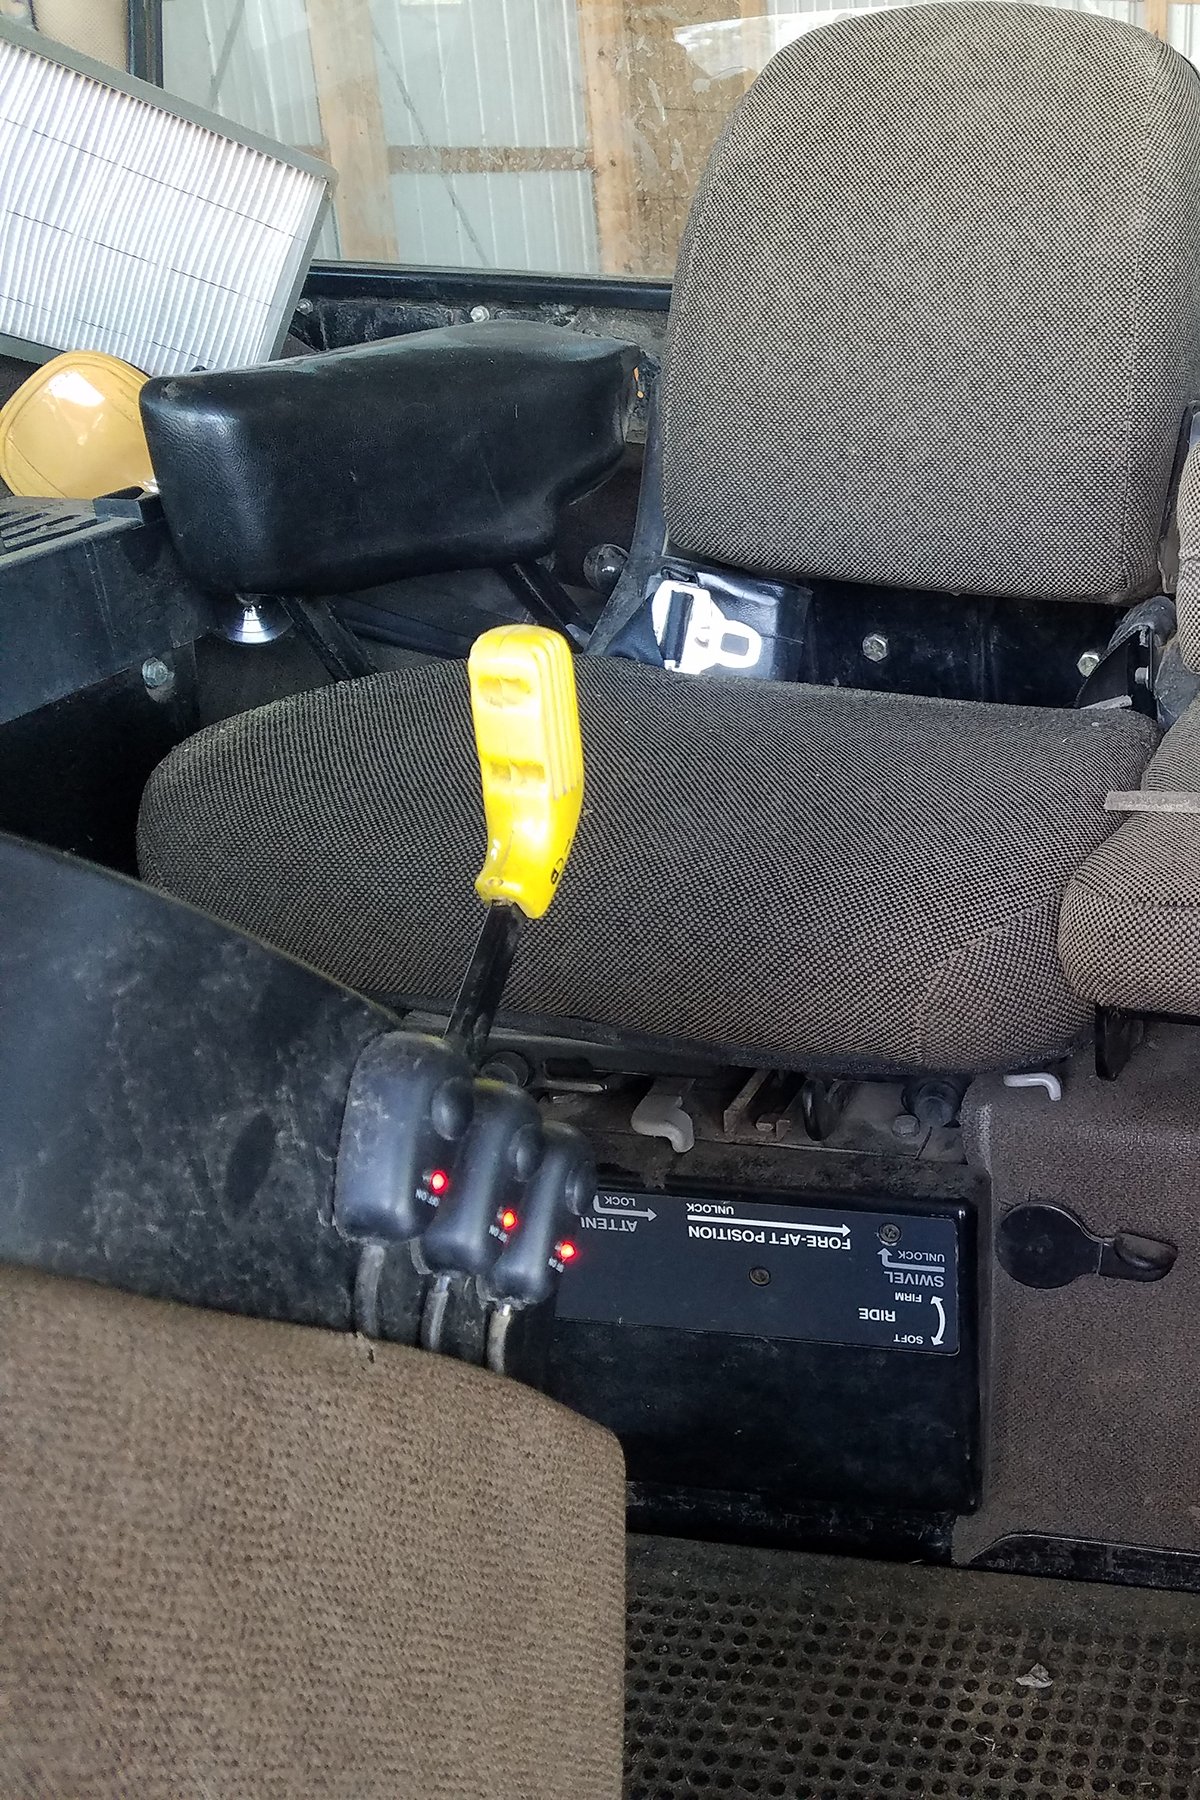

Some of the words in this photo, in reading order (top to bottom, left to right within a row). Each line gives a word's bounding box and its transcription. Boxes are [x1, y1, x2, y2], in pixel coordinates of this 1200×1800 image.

[604, 1195, 635, 1207] LOCK
[686, 1202, 734, 1215] UNLOCK
[688, 1225, 765, 1244] POSITION
[769, 1233, 851, 1250] FORE-AFT
[898, 1250, 945, 1263] UNLOCK
[884, 1271, 944, 1288] SWIVEL
[895, 1292, 922, 1303] FIRM
[858, 1308, 896, 1322] RIDE
[893, 1334, 924, 1345] SOFT
